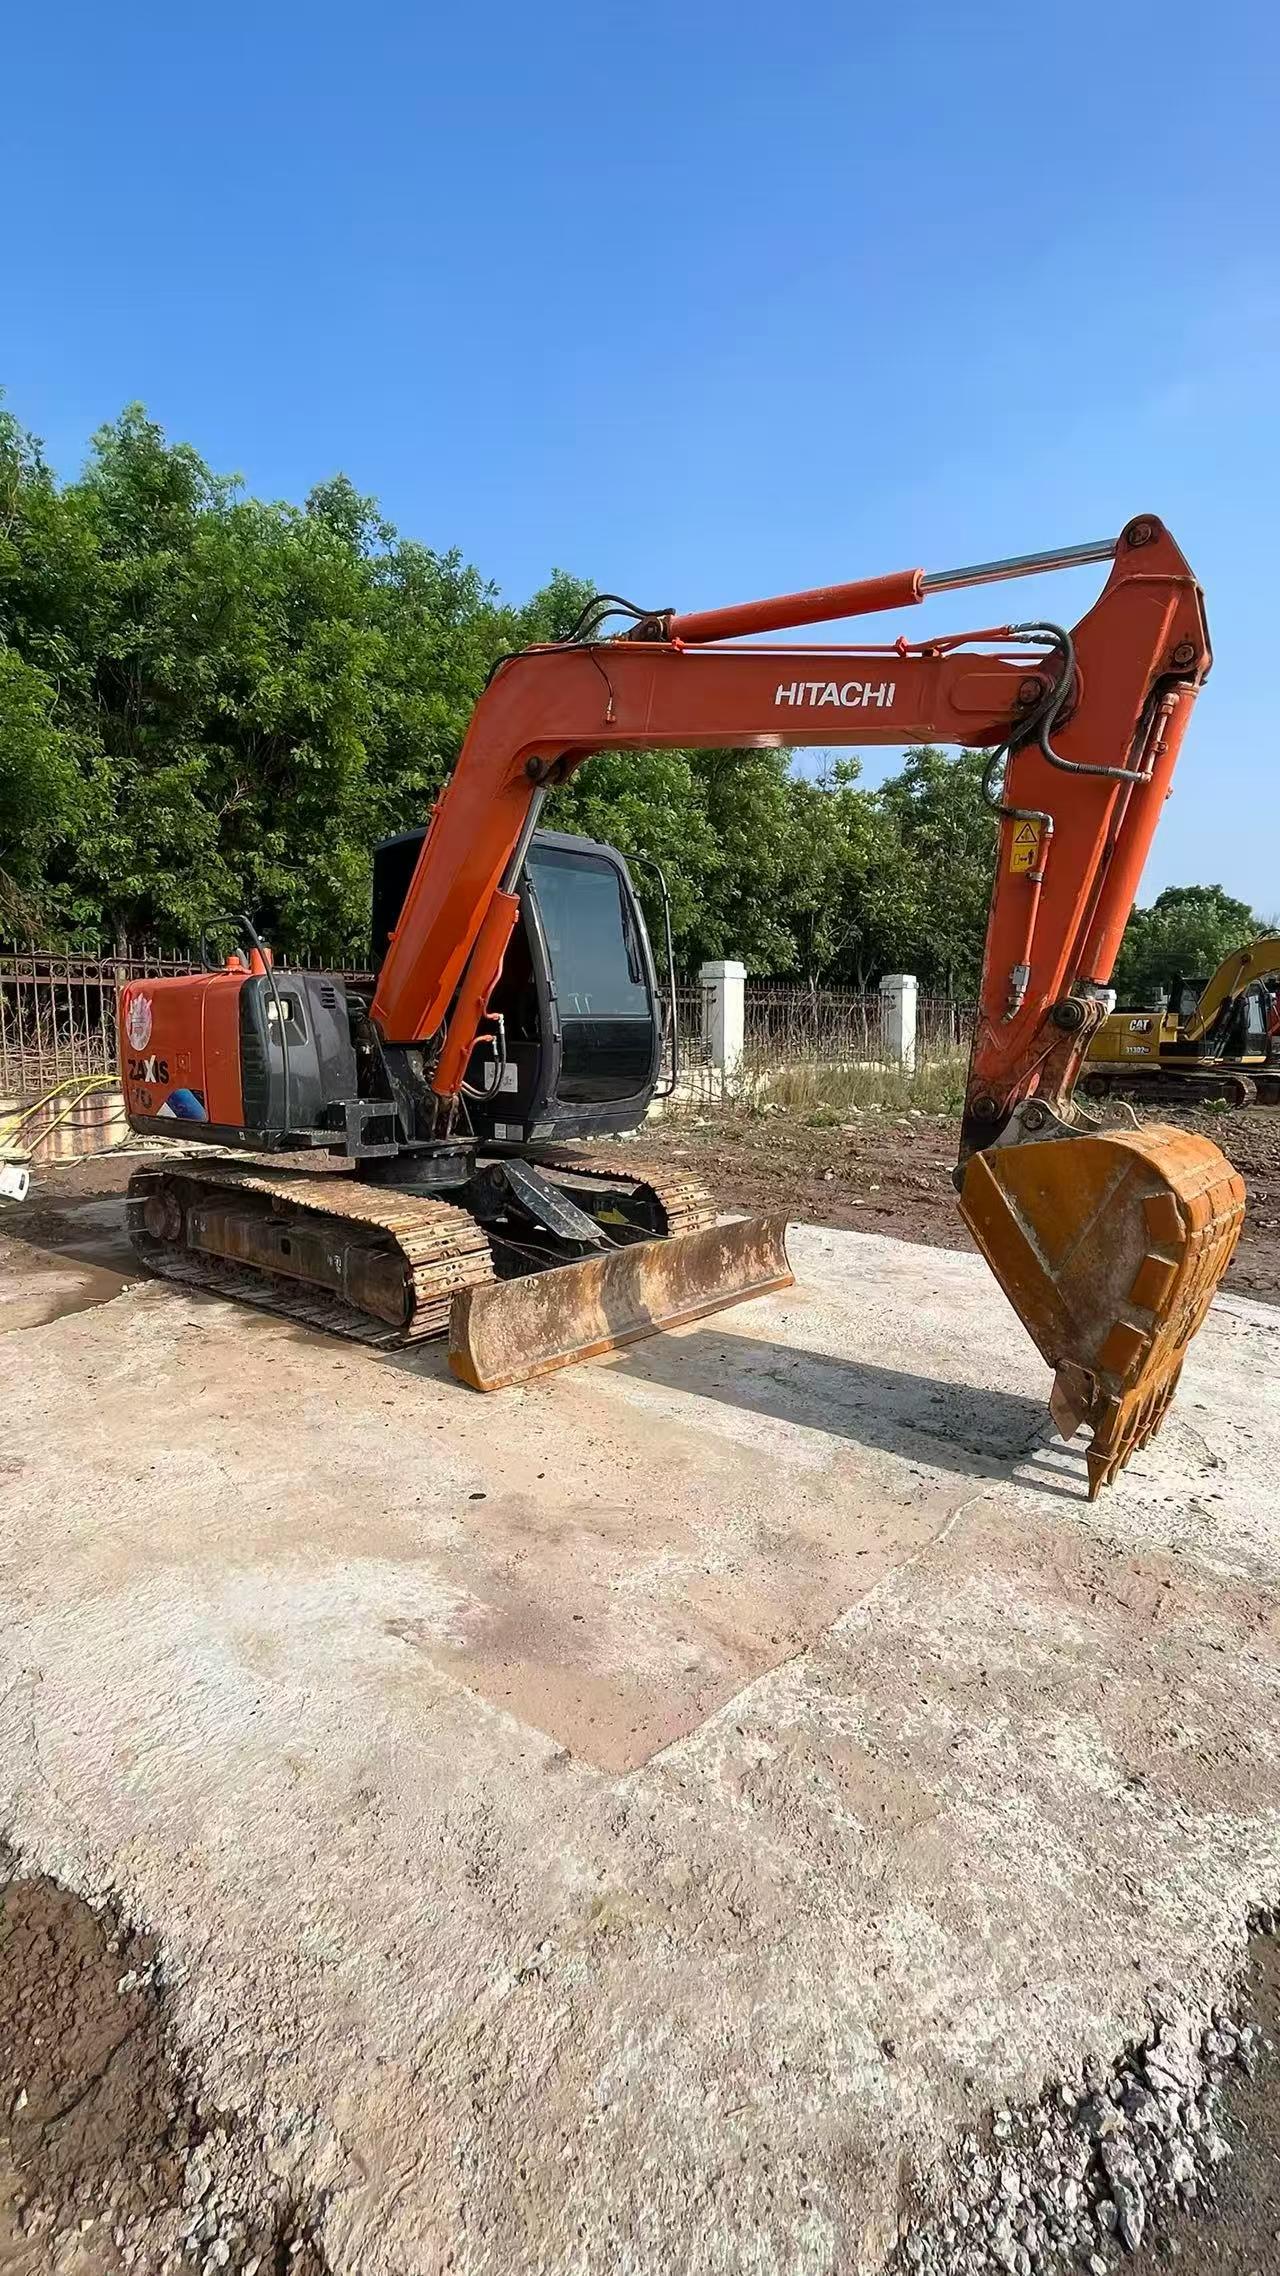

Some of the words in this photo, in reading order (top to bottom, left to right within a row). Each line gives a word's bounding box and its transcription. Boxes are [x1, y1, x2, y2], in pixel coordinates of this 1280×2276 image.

[775, 682, 896, 707] HITACHI
[1129, 1019, 1150, 1031] CAT
[128, 1055, 170, 1084] ZAXIS
